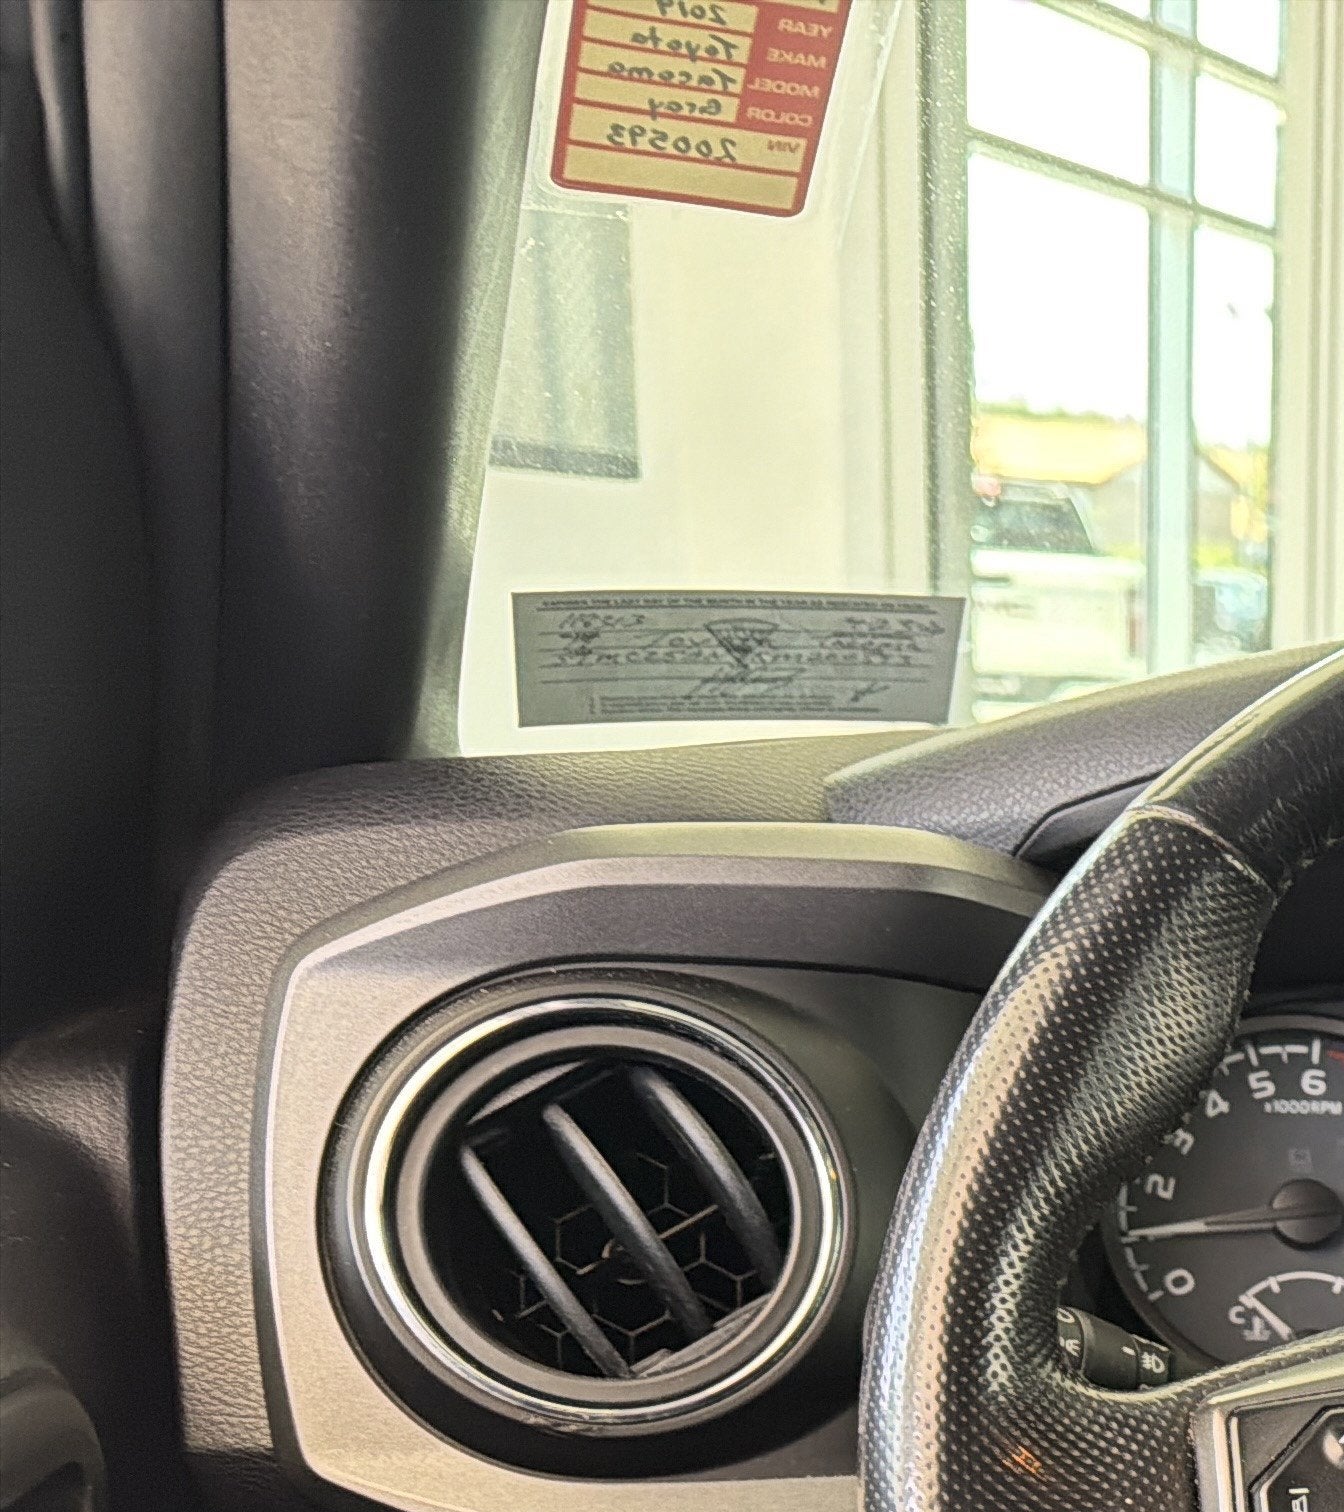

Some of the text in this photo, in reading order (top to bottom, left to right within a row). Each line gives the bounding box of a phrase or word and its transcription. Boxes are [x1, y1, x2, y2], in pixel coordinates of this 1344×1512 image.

[1248, 1070, 1276, 1100] 5
[1301, 1069, 1327, 1096] 6
[1205, 1089, 1230, 1118] 4
[1167, 1127, 1195, 1155] 3
[1145, 1173, 1176, 1200] 2
[1164, 1268, 1195, 1297] 0
